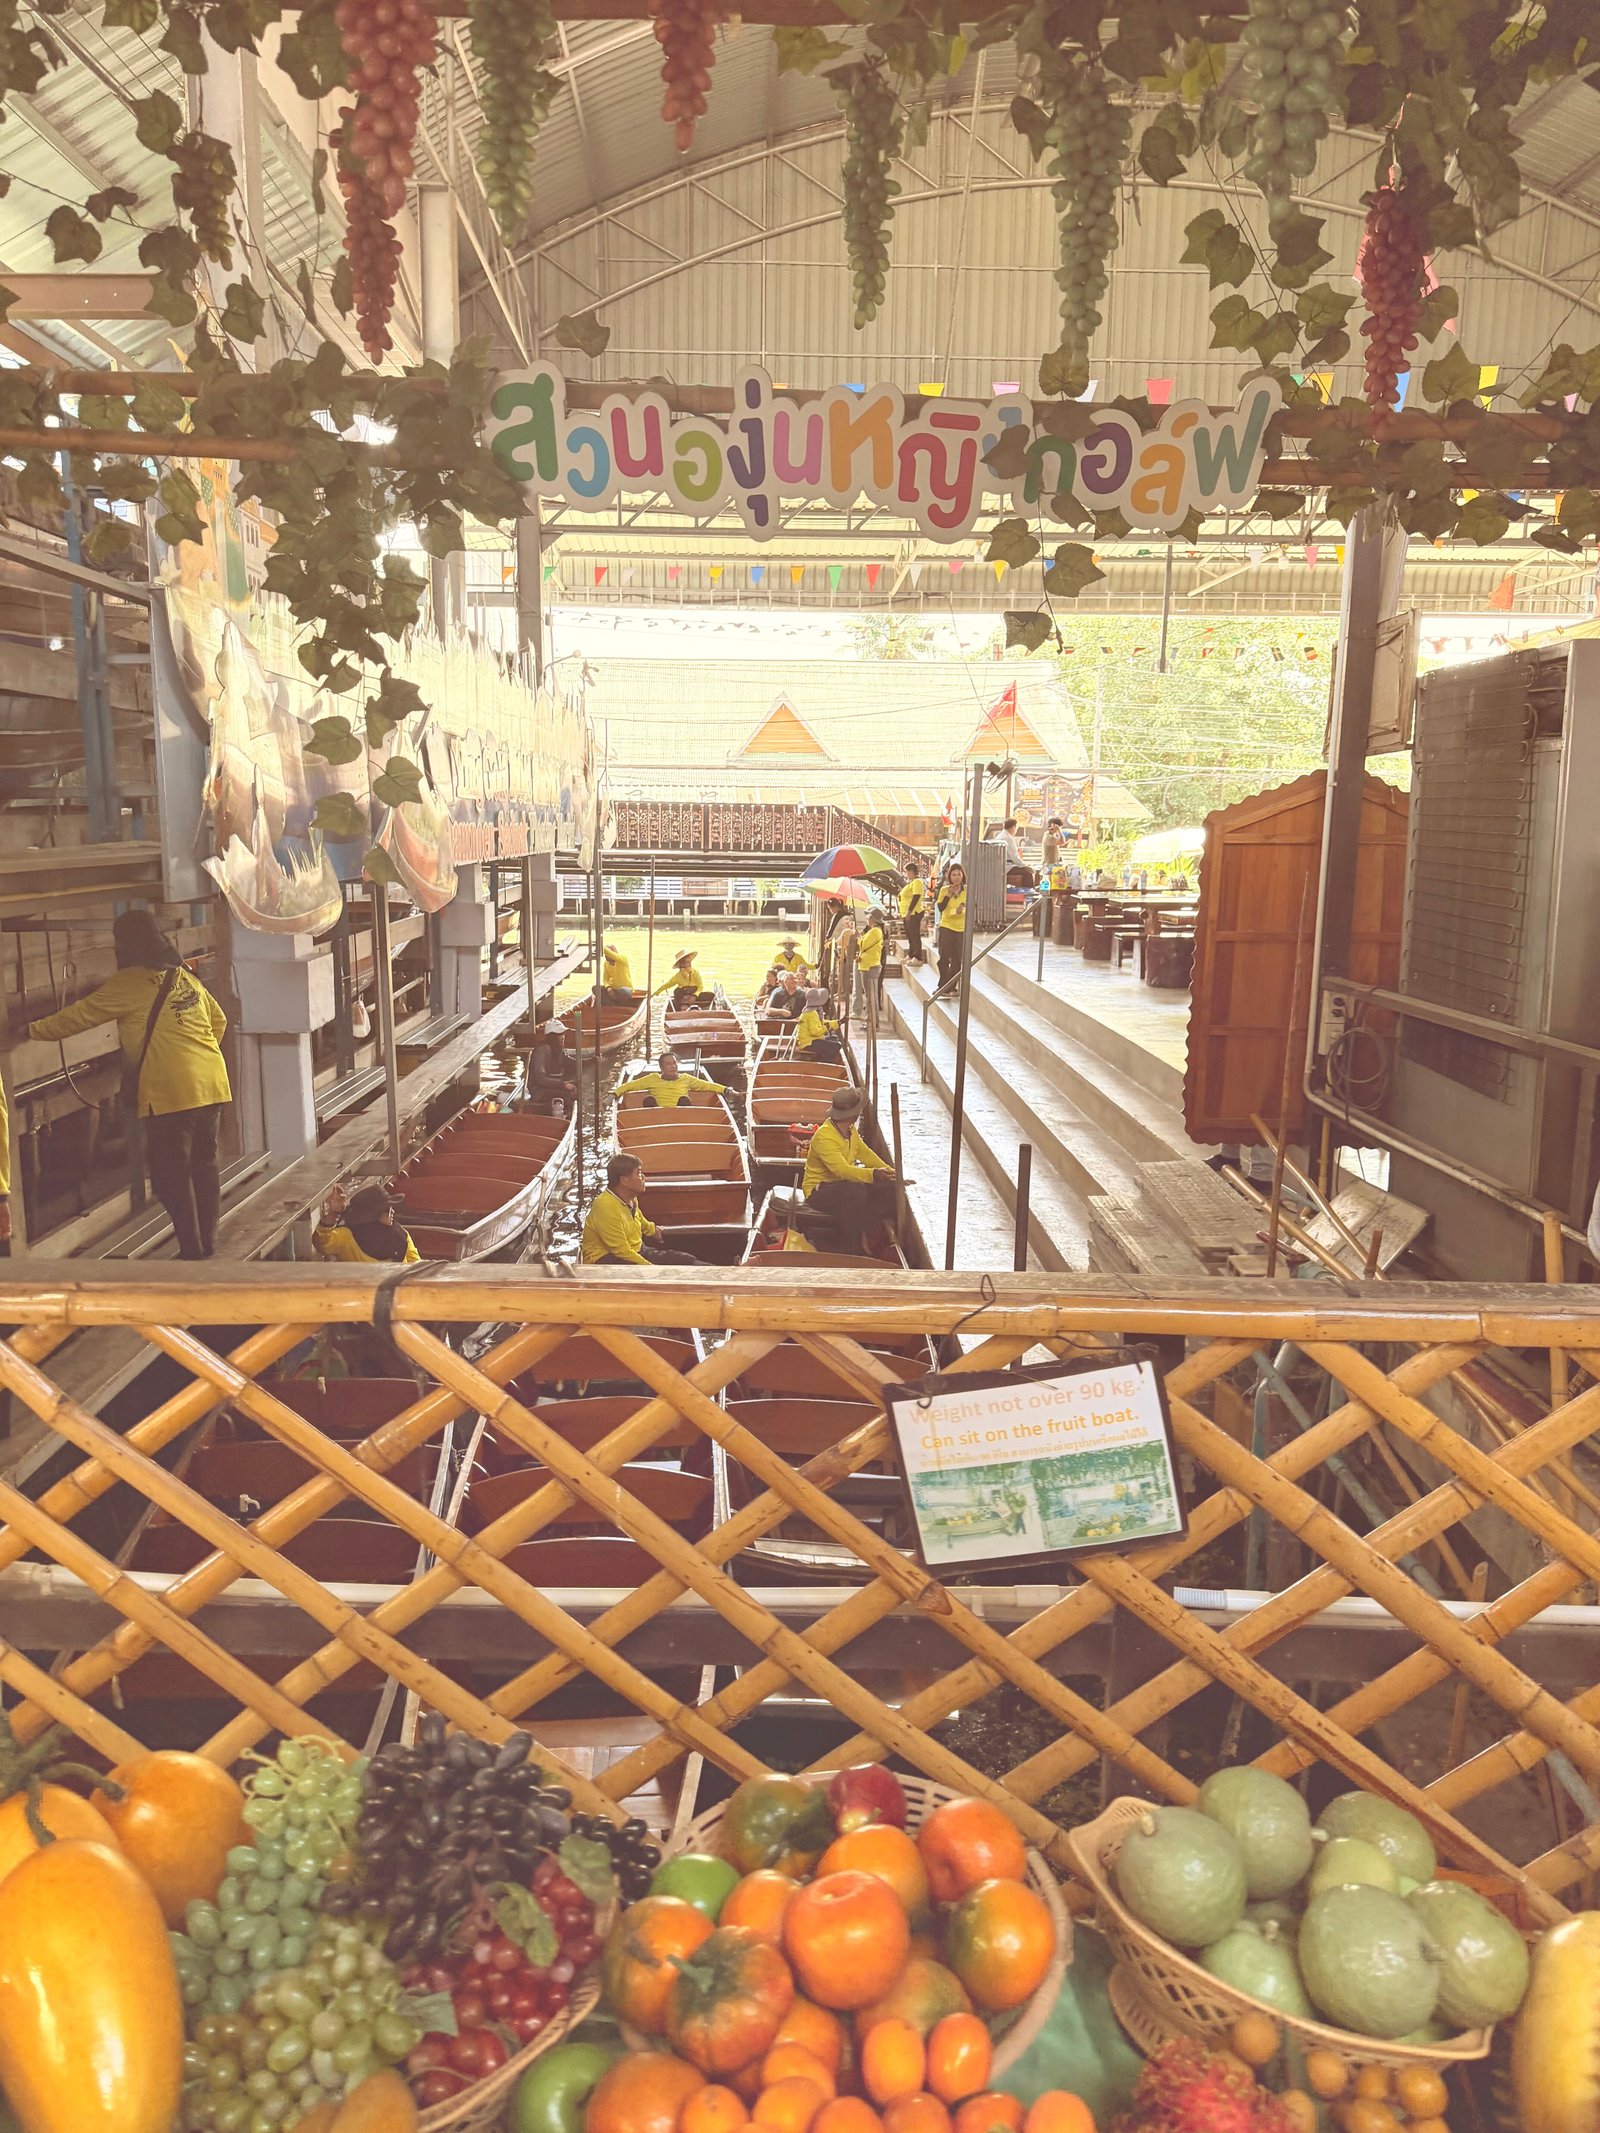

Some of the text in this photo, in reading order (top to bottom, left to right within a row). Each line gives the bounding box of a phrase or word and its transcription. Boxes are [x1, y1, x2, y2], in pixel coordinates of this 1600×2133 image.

[909, 1402, 982, 1425] Weight
[988, 1396, 1024, 1413] not
[1029, 1390, 1074, 1409] over
[1080, 1381, 1105, 1401] 90
[920, 1407, 1139, 1450] Can sit on the fruit boat.
